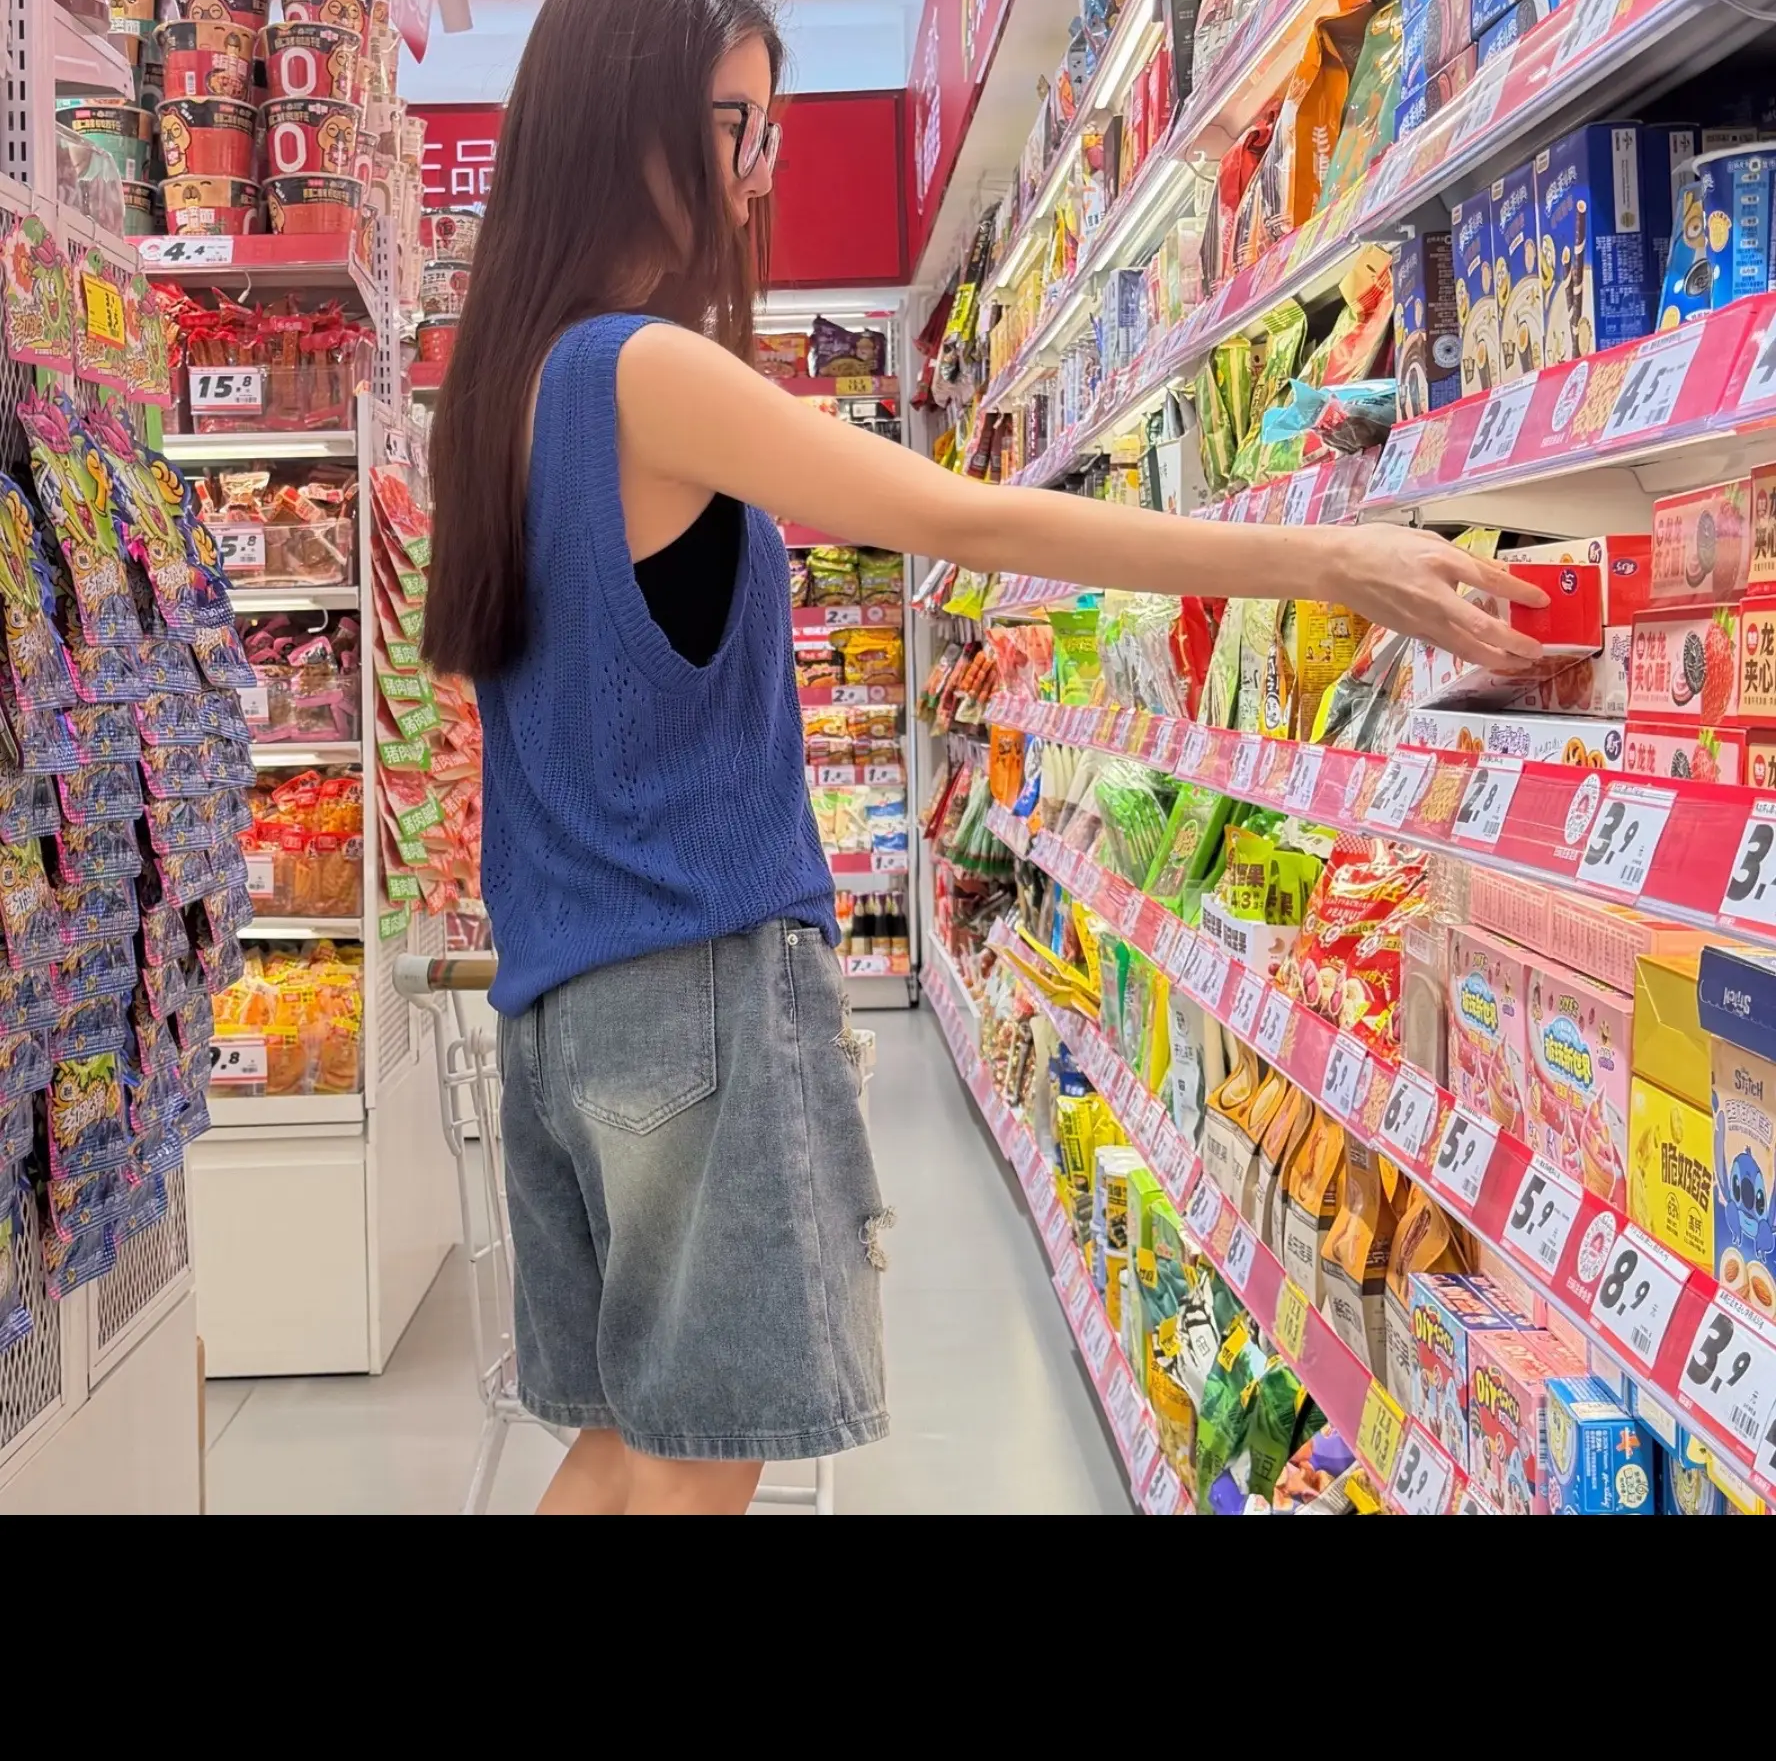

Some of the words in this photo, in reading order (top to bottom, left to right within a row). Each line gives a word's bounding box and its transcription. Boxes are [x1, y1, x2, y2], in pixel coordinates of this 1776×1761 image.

[163, 242, 205, 261] 4.4
[199, 375, 252, 399] 15.8
[1613, 359, 1667, 429] 4.5
[1743, 659, 1774, 694] 夹心
[1457, 769, 1499, 823] 2.8
[1584, 801, 1640, 865] 3.9
[1726, 824, 1776, 901] 3.
[1384, 1083, 1415, 1133] 6.9
[1734, 1070, 1764, 1098] STITCH
[1438, 1116, 1476, 1173] 5.9
[1510, 1174, 1555, 1235] 5.9
[1599, 1249, 1651, 1316] 8.9
[1687, 1312, 1752, 1394] 3.9
[1396, 1443, 1429, 1499] 3.9
